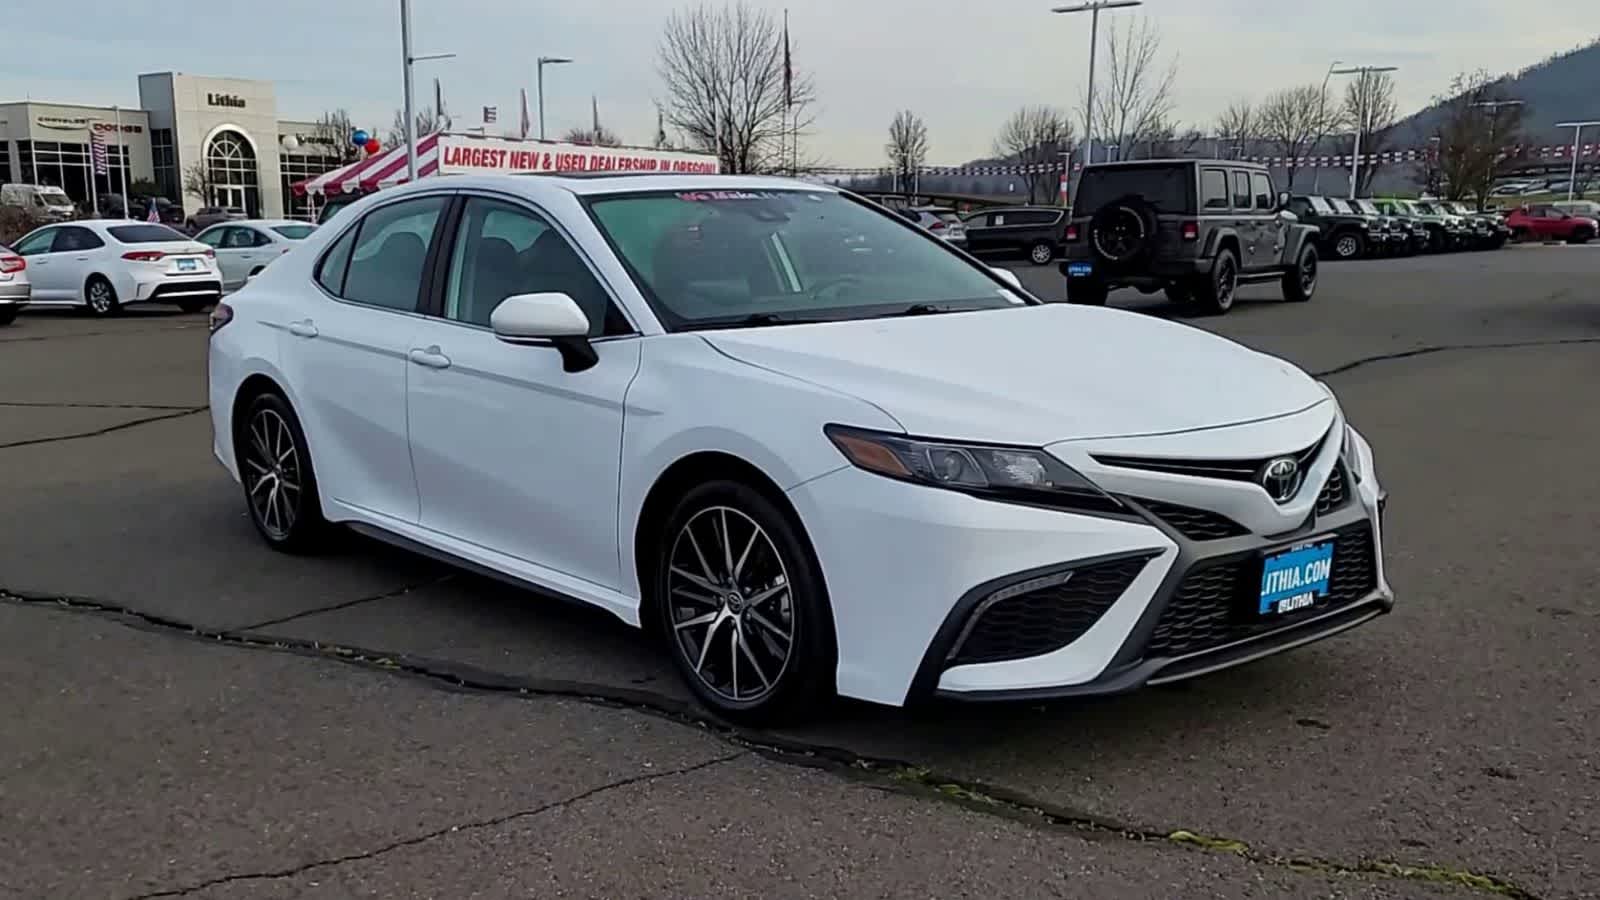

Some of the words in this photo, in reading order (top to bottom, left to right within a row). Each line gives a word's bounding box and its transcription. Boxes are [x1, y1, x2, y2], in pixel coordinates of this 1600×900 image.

[207, 92, 246, 108] Lithia
[444, 146, 507, 169] LARGEST
[509, 150, 540, 170] NEW
[542, 152, 552, 171] &
[555, 152, 587, 172] USED
[590, 154, 657, 171] DEALERSHIP
[1260, 557, 1332, 596] LITHIA.COM
